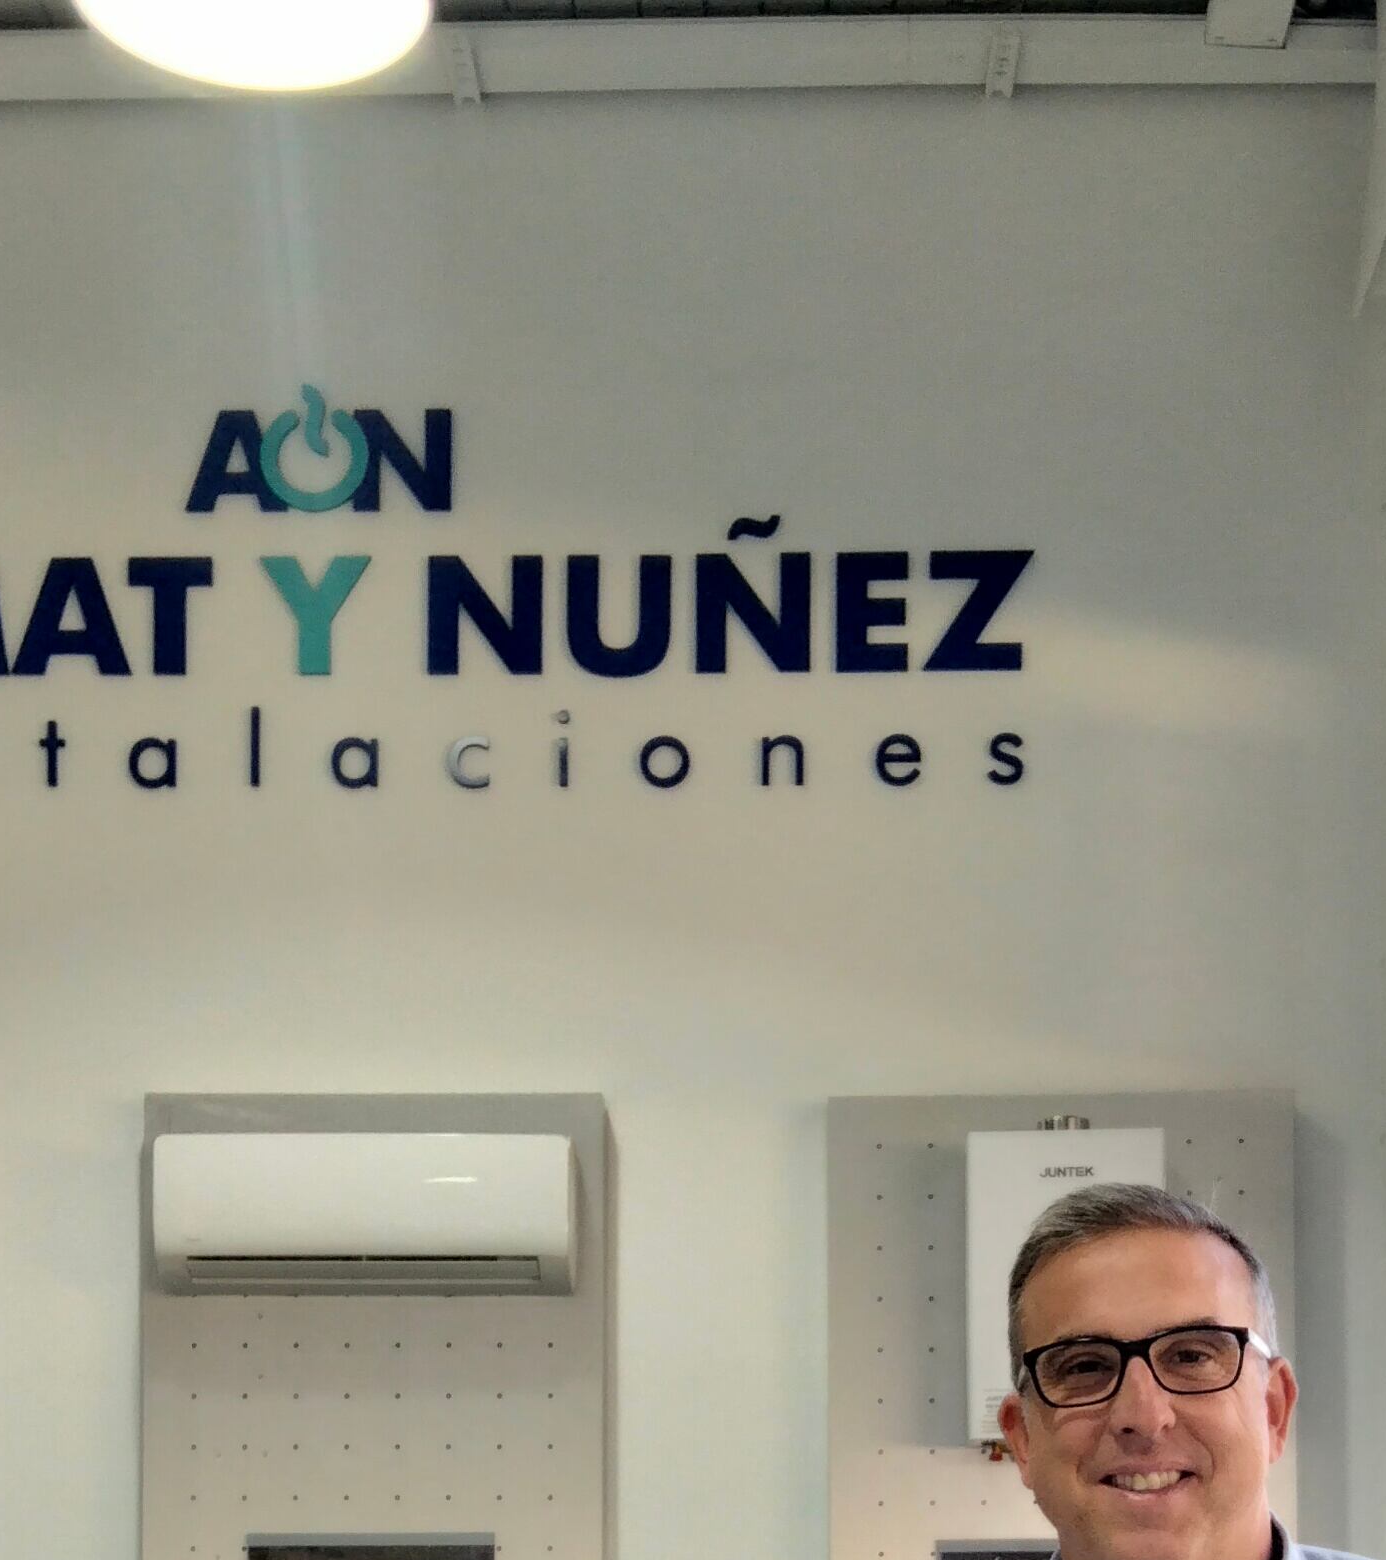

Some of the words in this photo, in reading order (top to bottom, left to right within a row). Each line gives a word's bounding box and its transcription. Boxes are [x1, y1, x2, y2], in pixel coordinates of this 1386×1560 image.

[260, 554, 373, 676] Y
[426, 514, 1036, 676] NUÑEZ
[1039, 1166, 1094, 1178] JUNTEK
